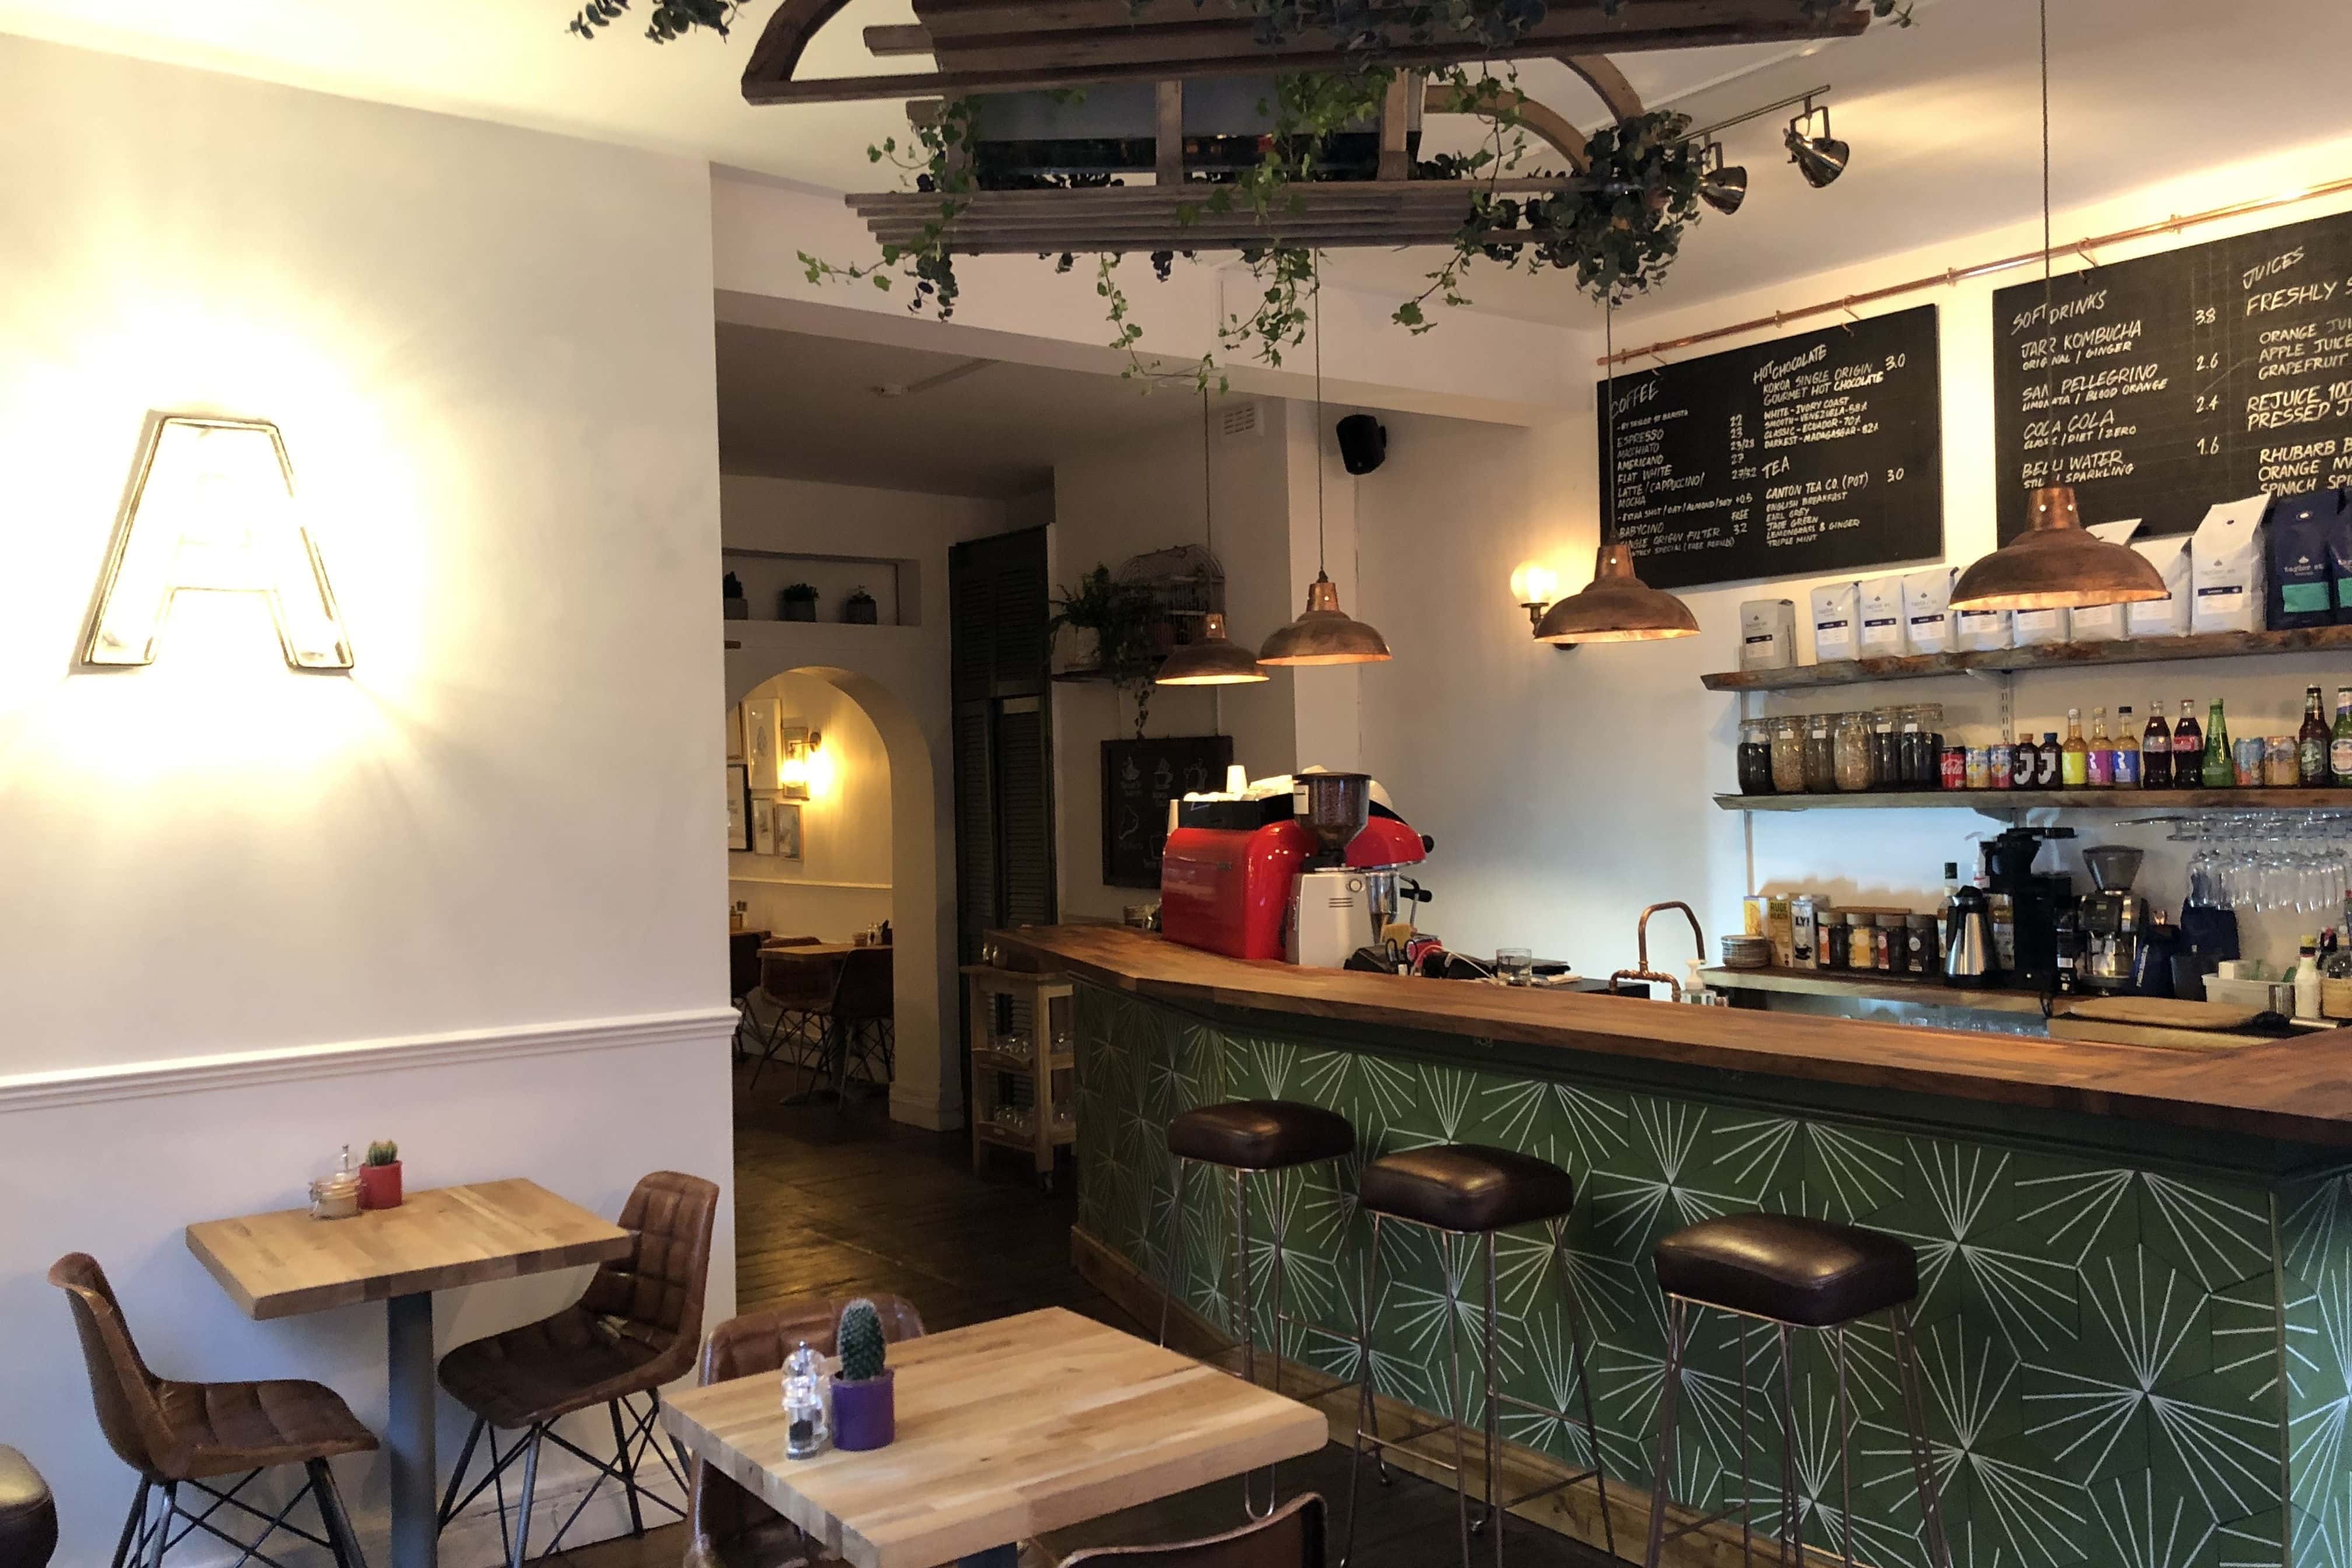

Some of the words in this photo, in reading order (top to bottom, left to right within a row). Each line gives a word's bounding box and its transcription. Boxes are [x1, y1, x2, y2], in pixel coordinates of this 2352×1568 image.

[2243, 246, 2305, 290] JUICES
[2246, 281, 2338, 317] FRESHLY
[2011, 302, 2048, 336] SOFT
[2049, 289, 2108, 325] DRINKS
[2064, 320, 2142, 351] KOMBUCHA
[2259, 323, 2317, 345] ORANGE
[2022, 354, 2070, 371] ORIGNAL
[2086, 341, 2132, 359] GINGER
[2259, 343, 2305, 363] APPLE
[2314, 334, 2352, 354] JUICE
[1753, 360, 1774, 384] HOT
[1772, 344, 1827, 380] CHOCOLATE
[1763, 379, 1790, 395] KOKOA
[1796, 370, 1829, 387] SINGLE
[1834, 362, 1873, 380] ORIGIN
[1885, 352, 1906, 371] 3.0
[2062, 363, 2158, 394] PELLEGRINO
[2196, 352, 2218, 372] 2.6
[2258, 353, 2348, 380] GRAPEFRUIT
[1612, 380, 1659, 420] COFFEE
[1763, 388, 1808, 407] GOURMET
[1811, 382, 1832, 397] HOT
[1833, 371, 1884, 392] CHOCOLATE
[2086, 387, 2118, 402] BLOOD
[2122, 379, 2168, 395] ORANGE
[2246, 385, 2322, 413] REJUICE
[1764, 407, 1789, 420] WHITE
[1795, 401, 1822, 415] IVORY
[1824, 397, 1850, 408] COAST
[1764, 416, 1794, 430] SMOOTH
[1800, 407, 1845, 422] VENEZUELA
[2068, 409, 2115, 432] COLA
[2196, 395, 2218, 413] 2.4
[2248, 401, 2330, 432] PRESSED
[1617, 429, 1664, 448] ESPRESSO
[1764, 426, 1795, 440] CLASSIC
[1802, 418, 1838, 433] ECUADOR
[1764, 435, 1798, 449] DARKEST
[2260, 440, 2336, 464] RHUBARB
[1617, 454, 1664, 471] AMERICANO
[1762, 455, 1790, 479] TEA
[2070, 450, 2123, 471] WATER
[2259, 459, 2321, 482] ORANGE
[1618, 472, 1638, 485] FLAT
[1643, 464, 1672, 481] WHITE
[1766, 484, 1802, 500] CANTON
[1806, 480, 1822, 494] TEA
[1842, 471, 1869, 490] (POT)
[2024, 478, 2045, 489] STIL
[2065, 463, 2134, 484] SPARKLING
[2260, 477, 2317, 498] SPINACH
[1618, 496, 1646, 509] MOCHA
[1766, 499, 1798, 513] ENGLISH
[1802, 491, 1848, 506] BREAKFAST
[1619, 522, 1664, 538] BABYCINO
[1731, 509, 1749, 522] FREE
[1766, 512, 1785, 523] EARL
[1766, 525, 1815, 540] LEMONGRASS
[1829, 518, 1860, 530] GINGER
[1790, 516, 1819, 528] GREEN
[69, 408, 354, 672] A
[1686, 527, 1721, 542] FILTER
[1766, 536, 1793, 548] TRIPLE
[1796, 533, 1819, 544] MINT
